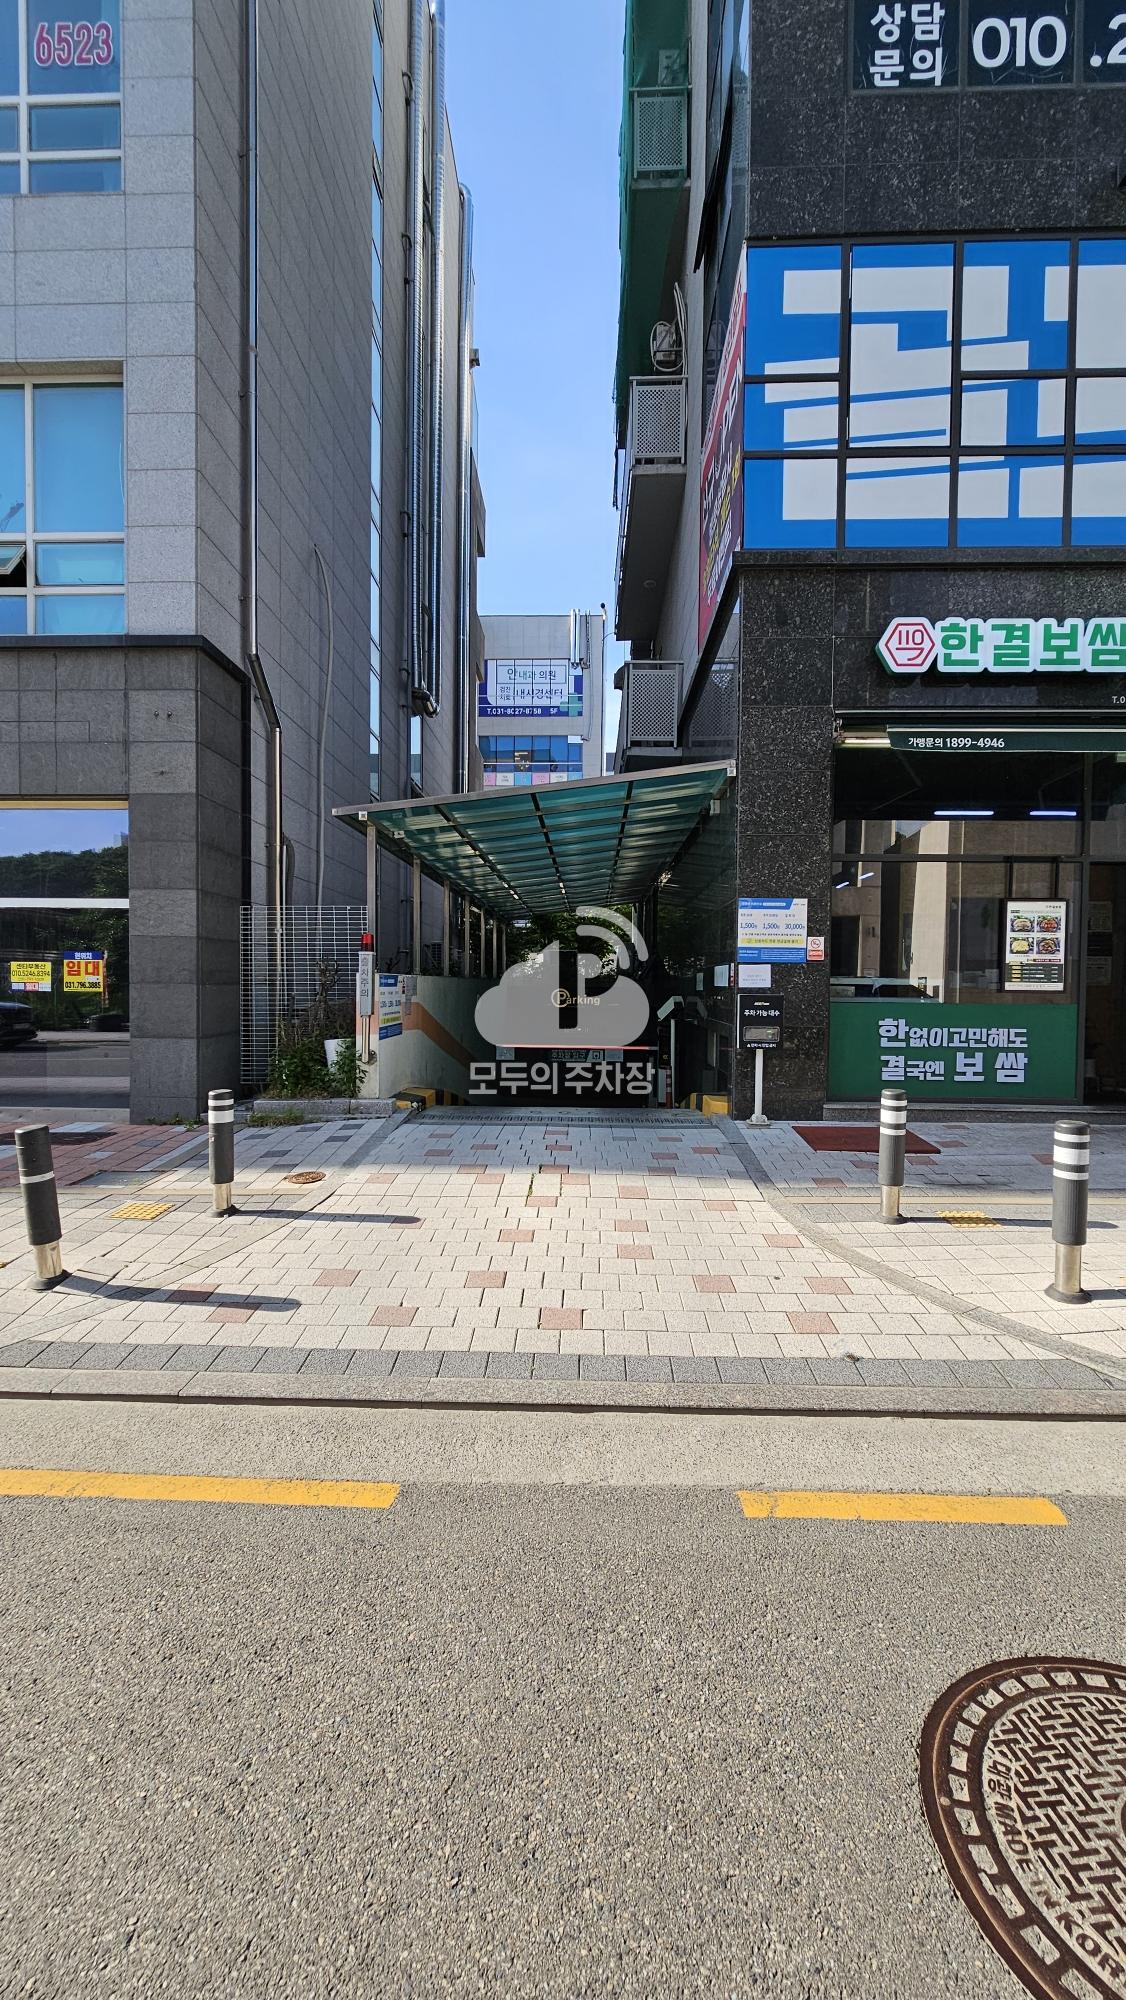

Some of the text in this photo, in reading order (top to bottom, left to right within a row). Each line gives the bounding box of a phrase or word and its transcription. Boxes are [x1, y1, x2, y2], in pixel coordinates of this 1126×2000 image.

[870, 2, 945, 43] 상담
[972, 15, 1067, 68] 010
[34, 21, 114, 67] 6523
[869, 47, 944, 87] 문의
[908, 737, 1005, 748] 가맹문의 1899-4946
[66, 961, 100, 977] 임대
[880, 1055, 945, 1081] 결국엔
